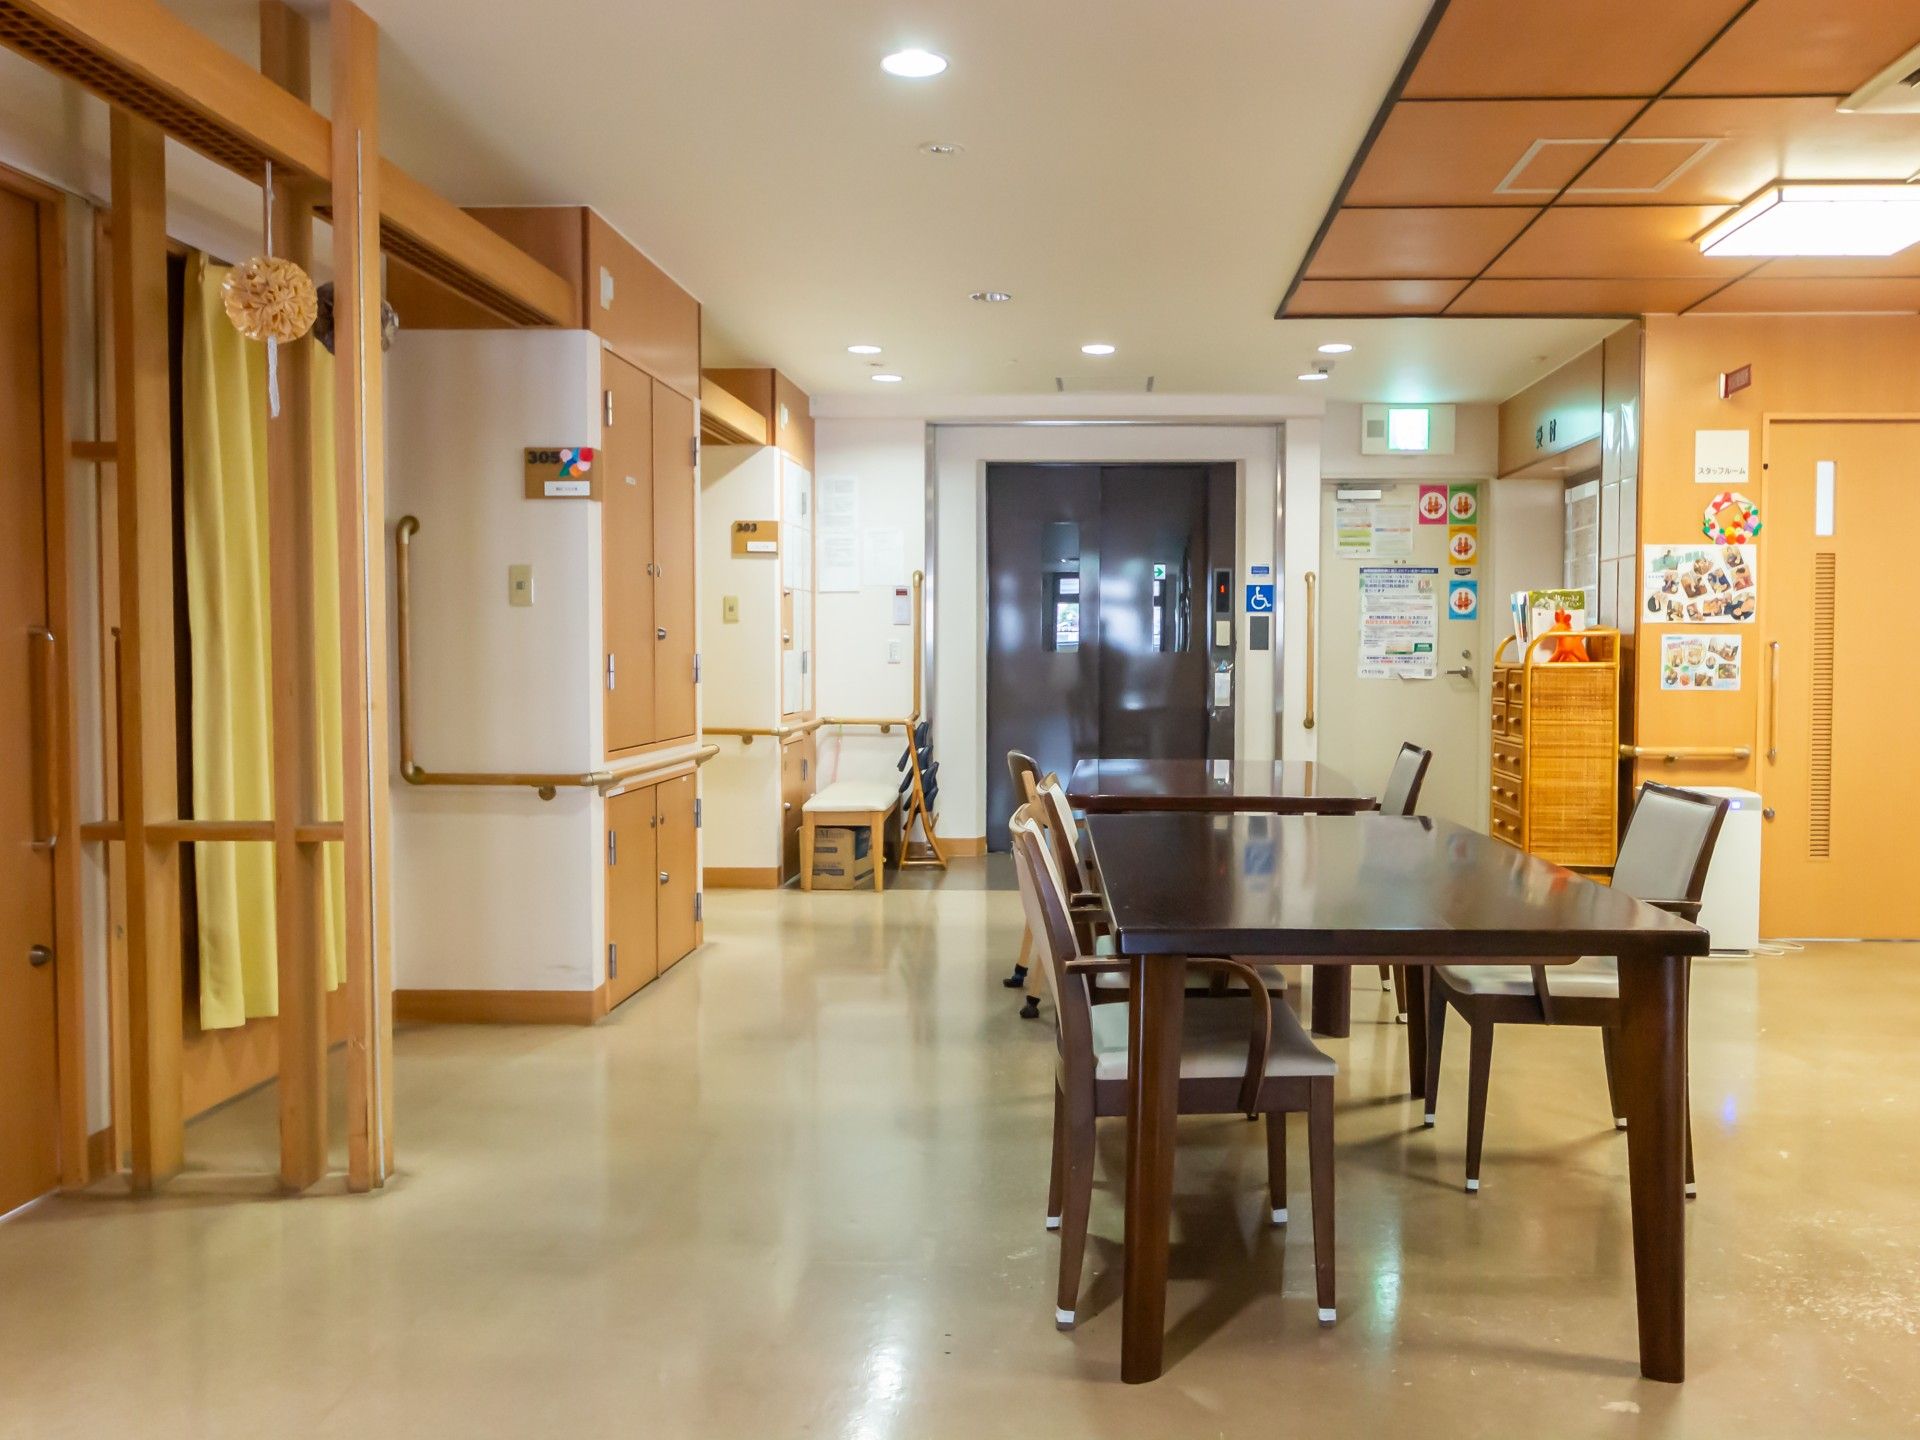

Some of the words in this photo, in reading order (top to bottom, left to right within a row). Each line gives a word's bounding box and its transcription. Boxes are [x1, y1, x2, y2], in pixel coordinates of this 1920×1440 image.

[1535, 419, 1557, 450] 受付
[527, 450, 561, 465] 305
[1697, 467, 1746, 475] スタッフルーム
